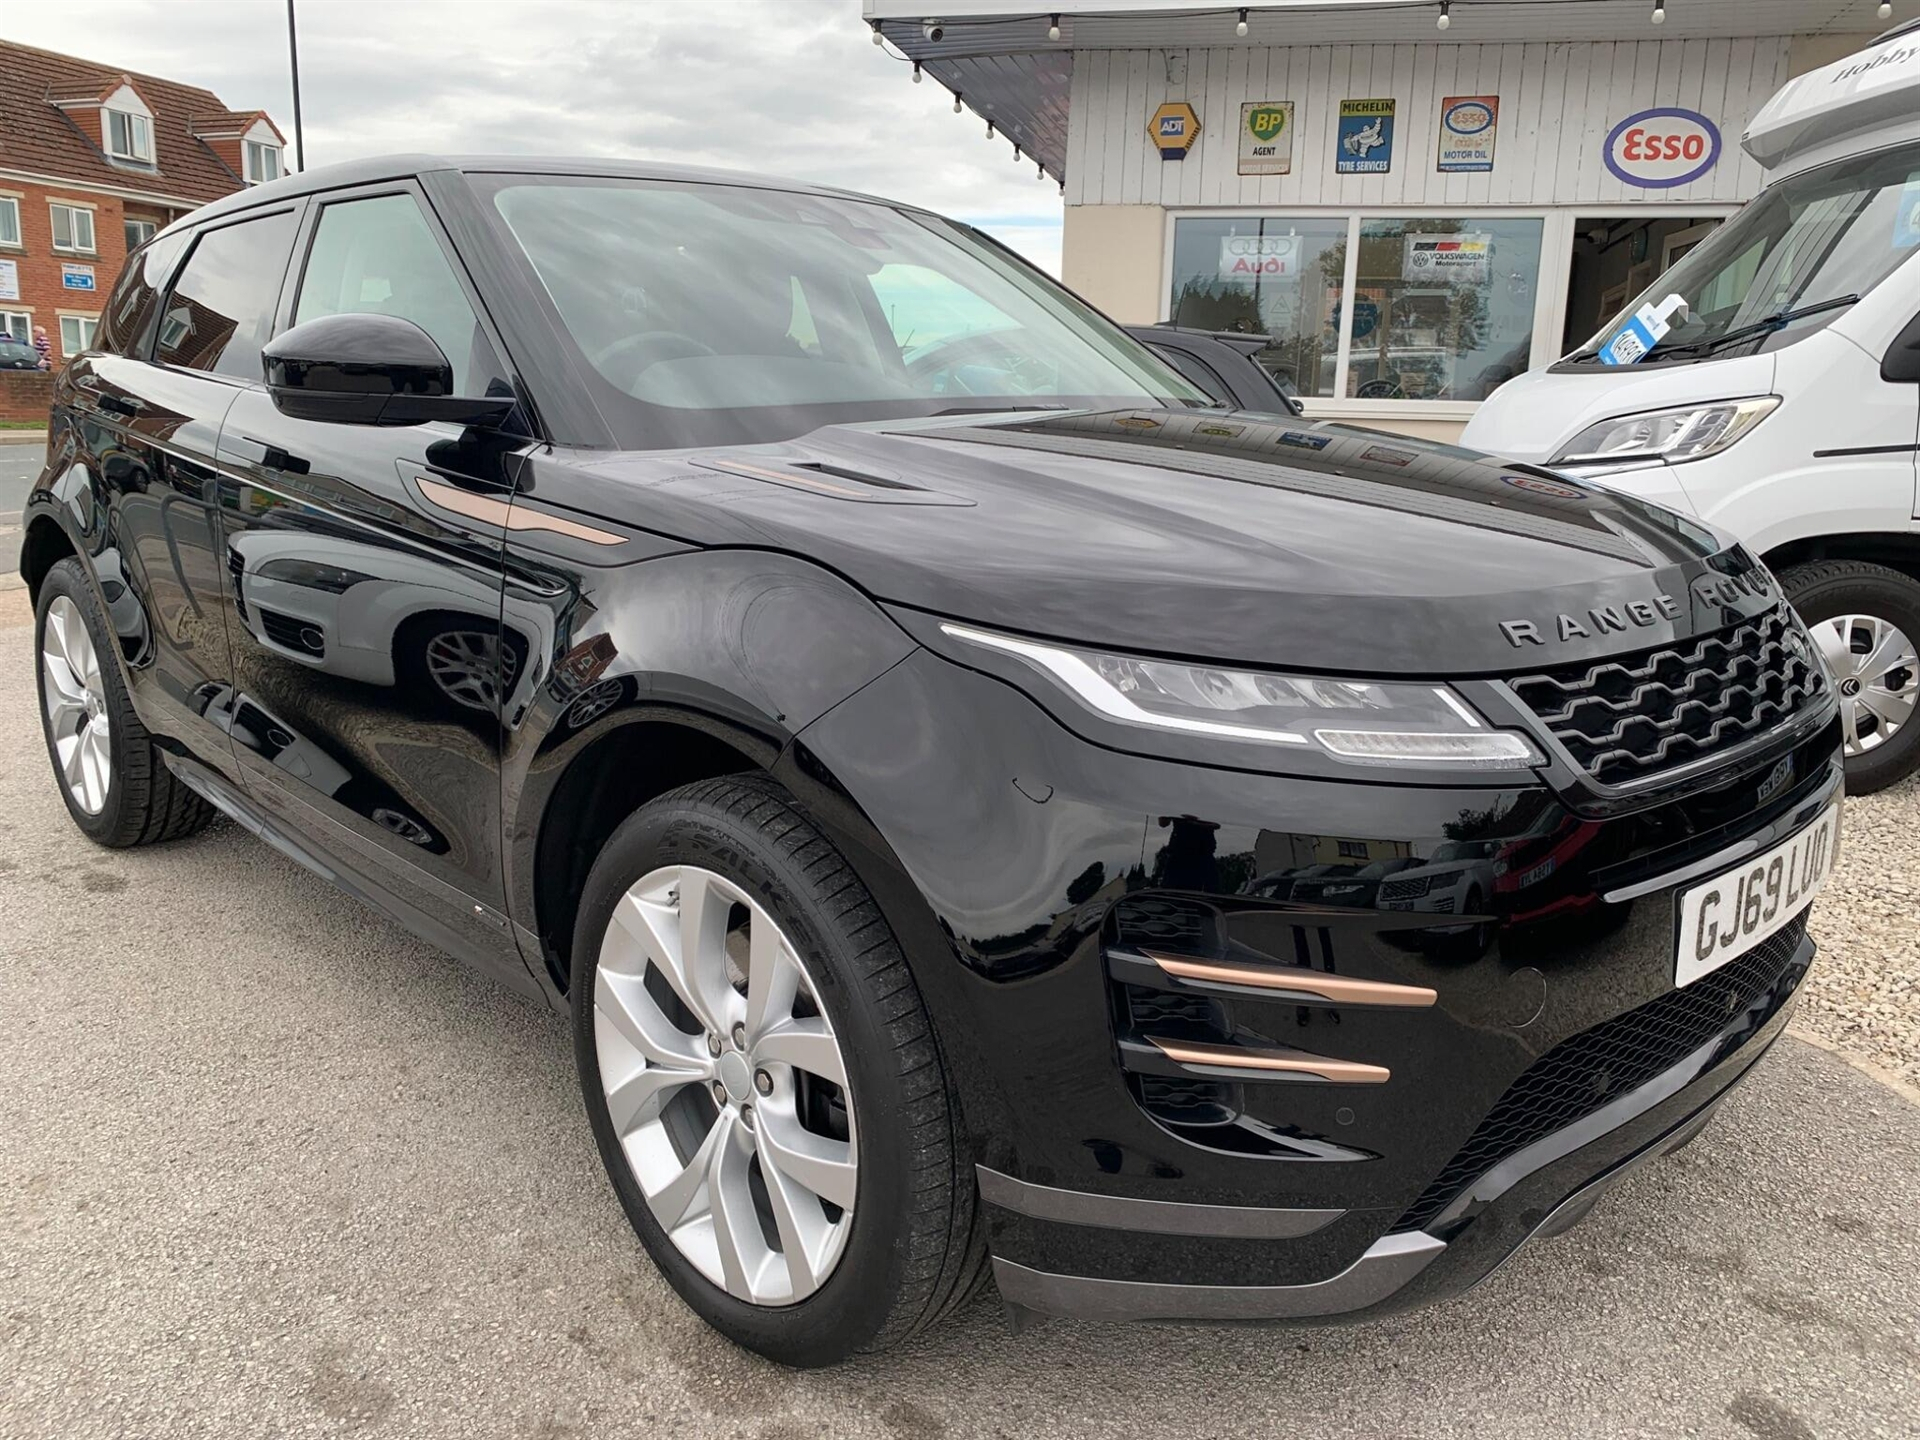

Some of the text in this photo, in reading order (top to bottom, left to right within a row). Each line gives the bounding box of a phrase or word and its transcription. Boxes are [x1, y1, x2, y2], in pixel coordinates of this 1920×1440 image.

[1829, 46, 1919, 84] Hobby
[1342, 102, 1392, 112] MICHELIN
[1161, 120, 1184, 132] ADT
[1254, 113, 1282, 132] BP
[1252, 147, 1276, 156] AGENT
[1443, 150, 1487, 159] MOTOR OIL
[1338, 160, 1388, 171] TYRE SERVICES
[1429, 252, 1485, 261] VOLKSWAGEN
[1231, 257, 1285, 274] Audi
[1435, 260, 1477, 268] Motorsport
[1498, 594, 1683, 648] RANGE
[1695, 820, 1829, 962] GJ69 LUO
